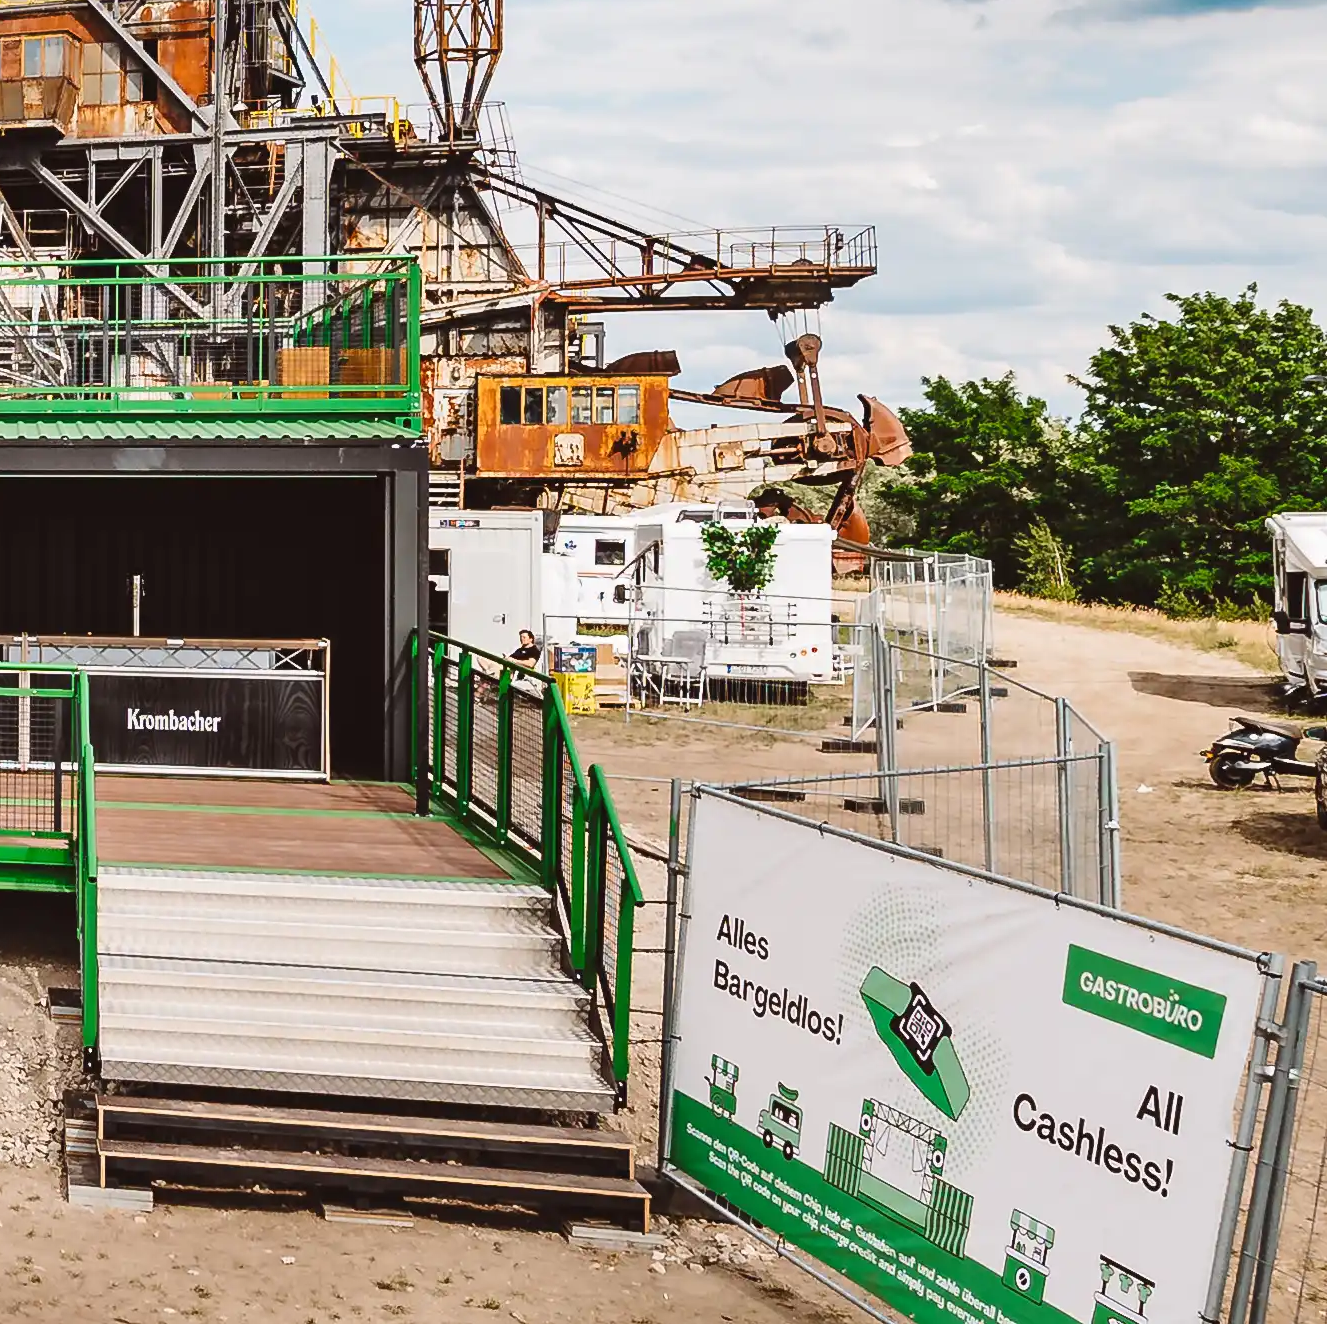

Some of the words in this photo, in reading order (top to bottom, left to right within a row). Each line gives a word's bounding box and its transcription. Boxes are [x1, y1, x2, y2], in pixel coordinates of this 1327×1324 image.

[127, 707, 222, 733] Krombacher
[716, 913, 769, 961] Alles
[713, 958, 844, 1046] Bargeldlos!
[1080, 971, 1203, 1032] GASTROBÜRO
[1013, 1092, 1174, 1198] Cashless!
[1136, 1084, 1184, 1136] All
[686, 1122, 713, 1146] Scanne
[713, 1138, 728, 1155] den
[727, 1146, 761, 1176] QR-Code
[760, 1170, 775, 1184] auf
[774, 1177, 803, 1202] deinem
[855, 1224, 897, 1259] Guthaben
[898, 1252, 917, 1269] auf
[917, 1262, 937, 1281] und
[935, 1274, 961, 1298] zahle
[961, 1287, 997, 1320] überall
[708, 1150, 727, 1171] Scan
[727, 1163, 740, 1180] the
[740, 1171, 754, 1189] QR
[753, 1181, 771, 1200] code
[771, 1193, 783, 1207] on
[782, 1200, 802, 1218] your
[820, 1224, 849, 1248] charge
[848, 1241, 878, 1264] credit
[878, 1257, 897, 1276] and
[896, 1269, 926, 1298] simply
[925, 1288, 946, 1310] pay
